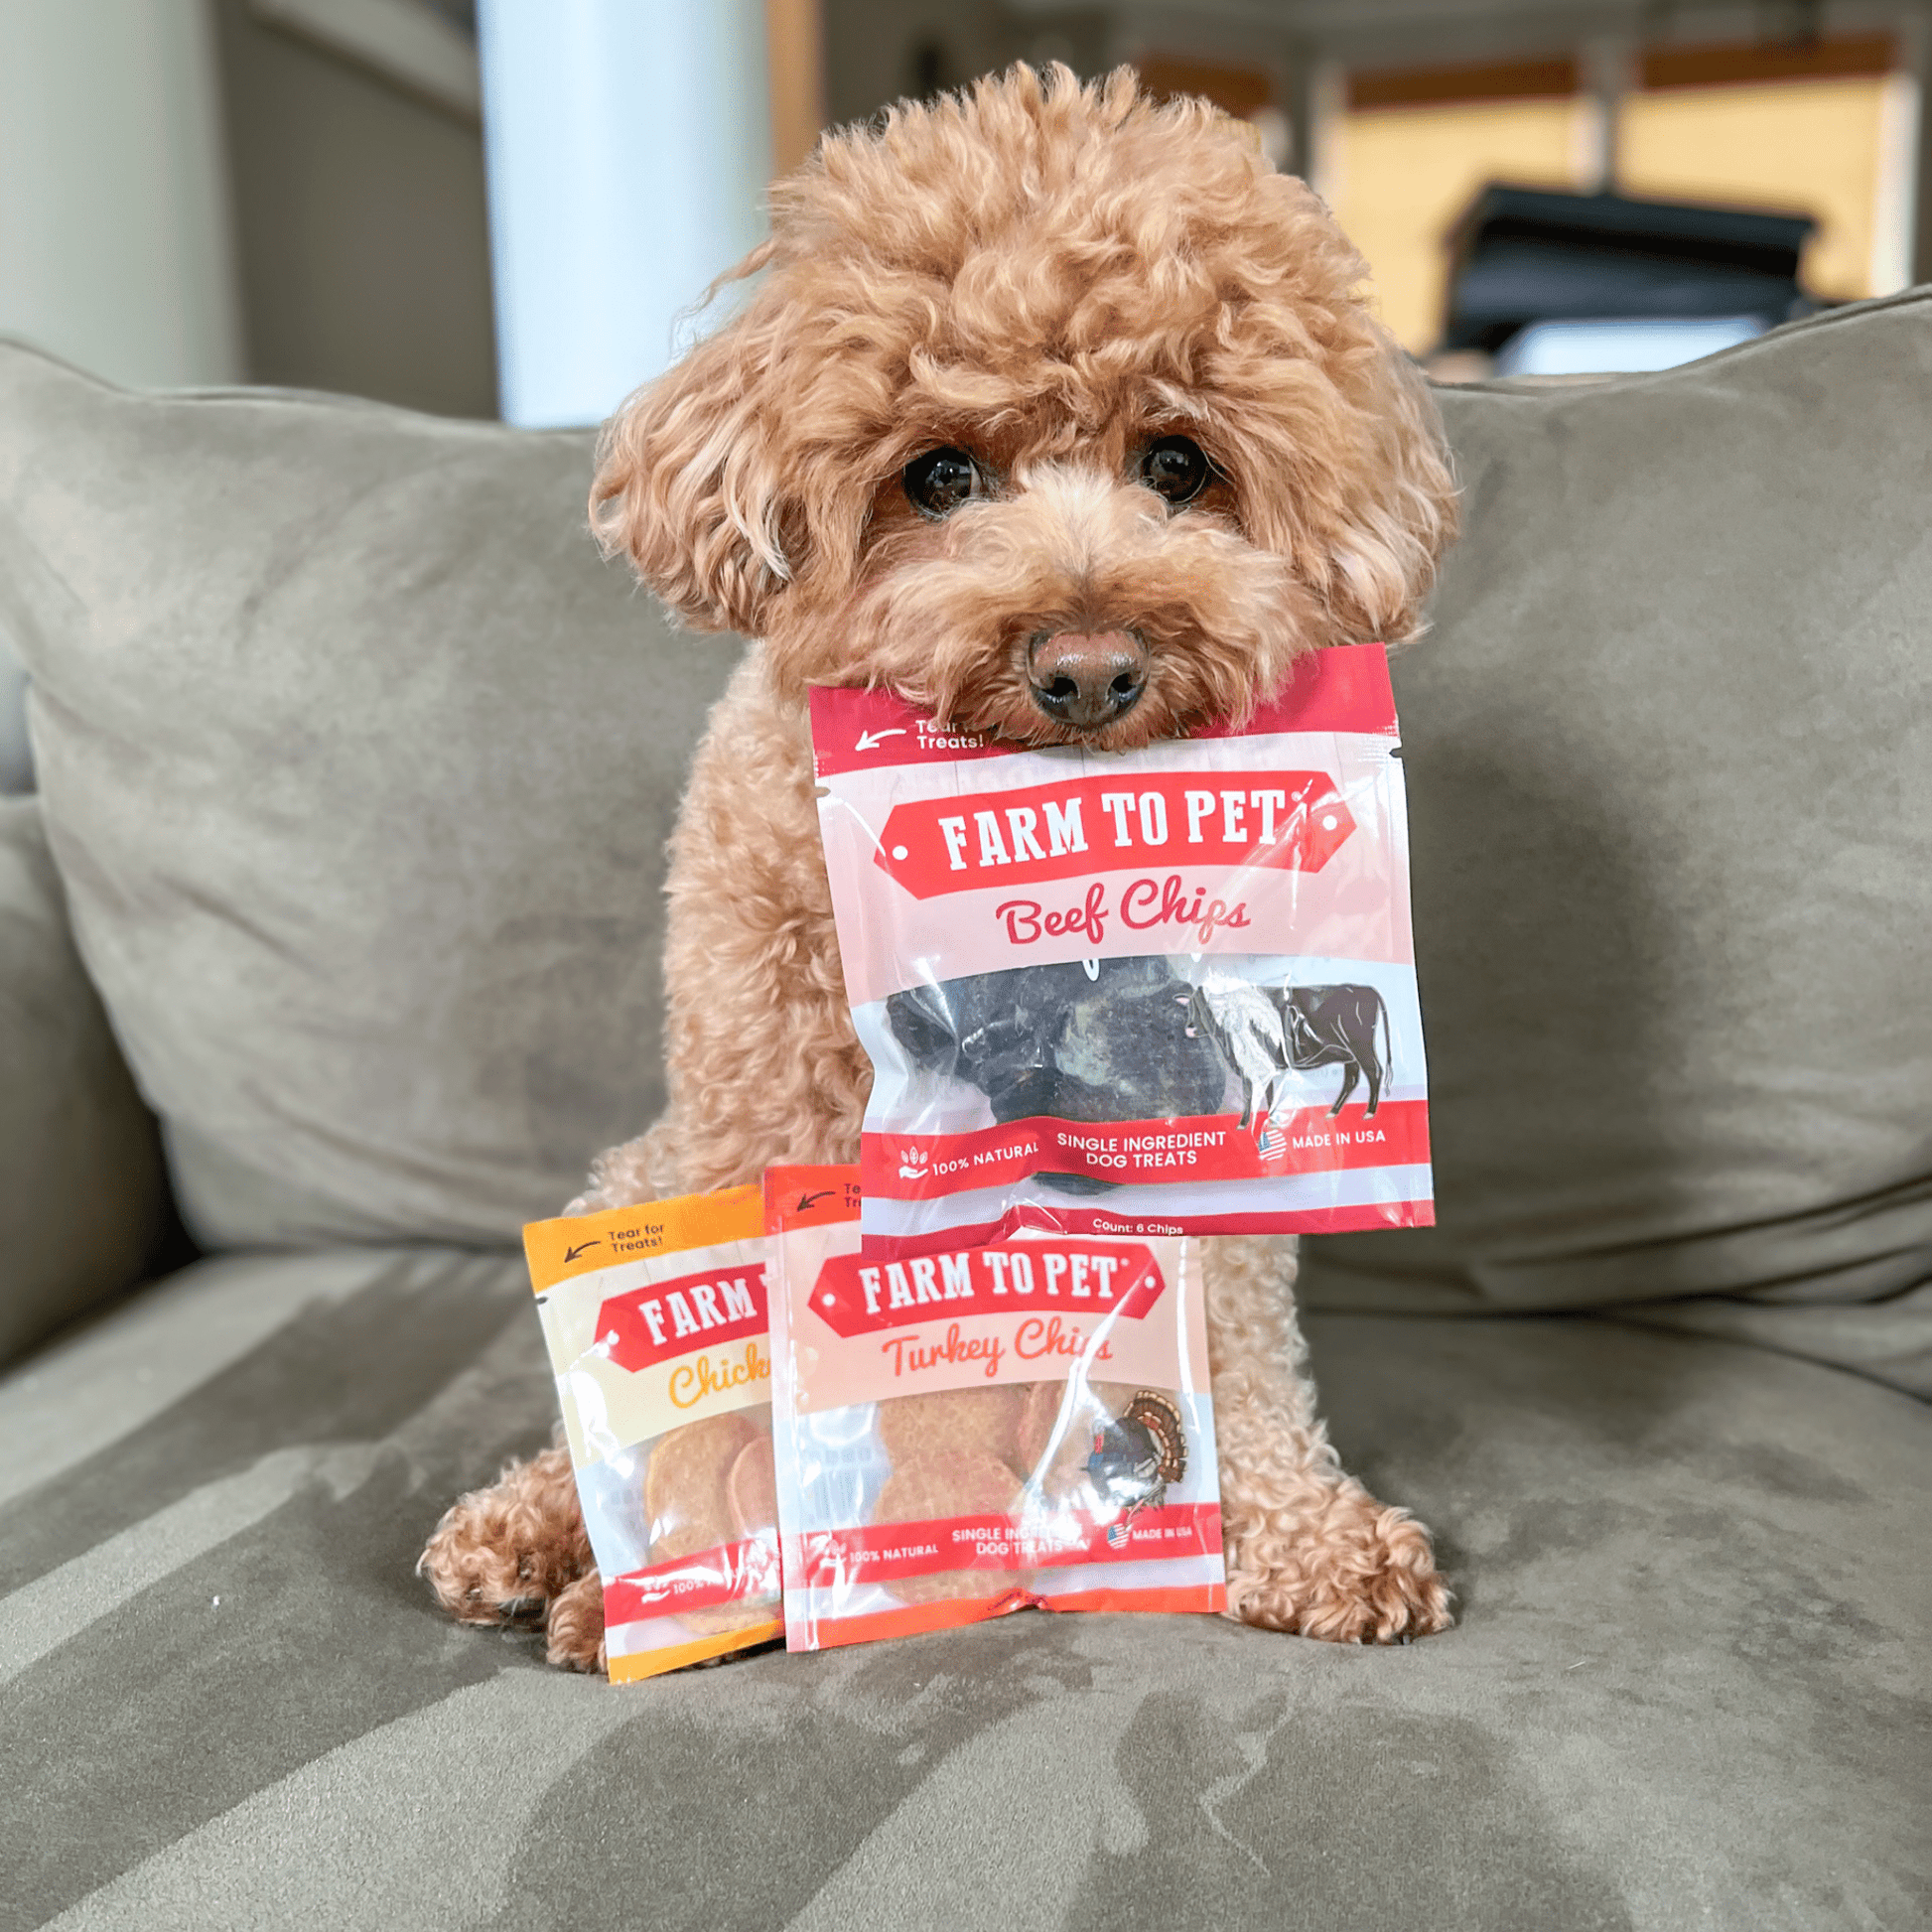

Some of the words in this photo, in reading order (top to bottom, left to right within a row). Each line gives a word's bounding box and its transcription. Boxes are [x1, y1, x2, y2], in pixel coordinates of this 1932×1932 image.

[916, 734, 984, 749] Treats!
[938, 797, 1089, 871] FARM
[1101, 791, 1169, 847] TO
[1184, 789, 1285, 844] PET
[996, 883, 1109, 944] Beef
[1120, 875, 1251, 944] Chips
[1057, 1133, 1117, 1152] SINGLE
[1124, 1131, 1226, 1151] INGREDIENT
[1293, 1134, 1331, 1149] MADE
[1335, 1132, 1350, 1145] IN
[1355, 1129, 1386, 1144] USA
[932, 1159, 969, 1175] 100%
[973, 1142, 1039, 1166] NATURAL
[1086, 1152, 1127, 1169] DOG
[1133, 1150, 1197, 1168] TREATS
[609, 1225, 640, 1240] Tear
[644, 1223, 664, 1235] for
[1093, 1218, 1133, 1232] Count:
[1136, 1223, 1145, 1232] 6
[1147, 1223, 1183, 1236] Chips
[612, 1236, 663, 1252] Treats!
[859, 1253, 974, 1313] FARM
[983, 1251, 1035, 1295] TO
[1042, 1253, 1118, 1299] PET
[638, 1278, 758, 1345] FARM
[882, 1322, 1006, 1377] Turkey
[668, 1342, 770, 1408] Chick
[952, 1528, 1001, 1542] SINGLE
[1133, 1528, 1163, 1540] MADE
[850, 1550, 881, 1564] 100%
[883, 1543, 938, 1562] NATURAL
[976, 1542, 1009, 1556] DOG
